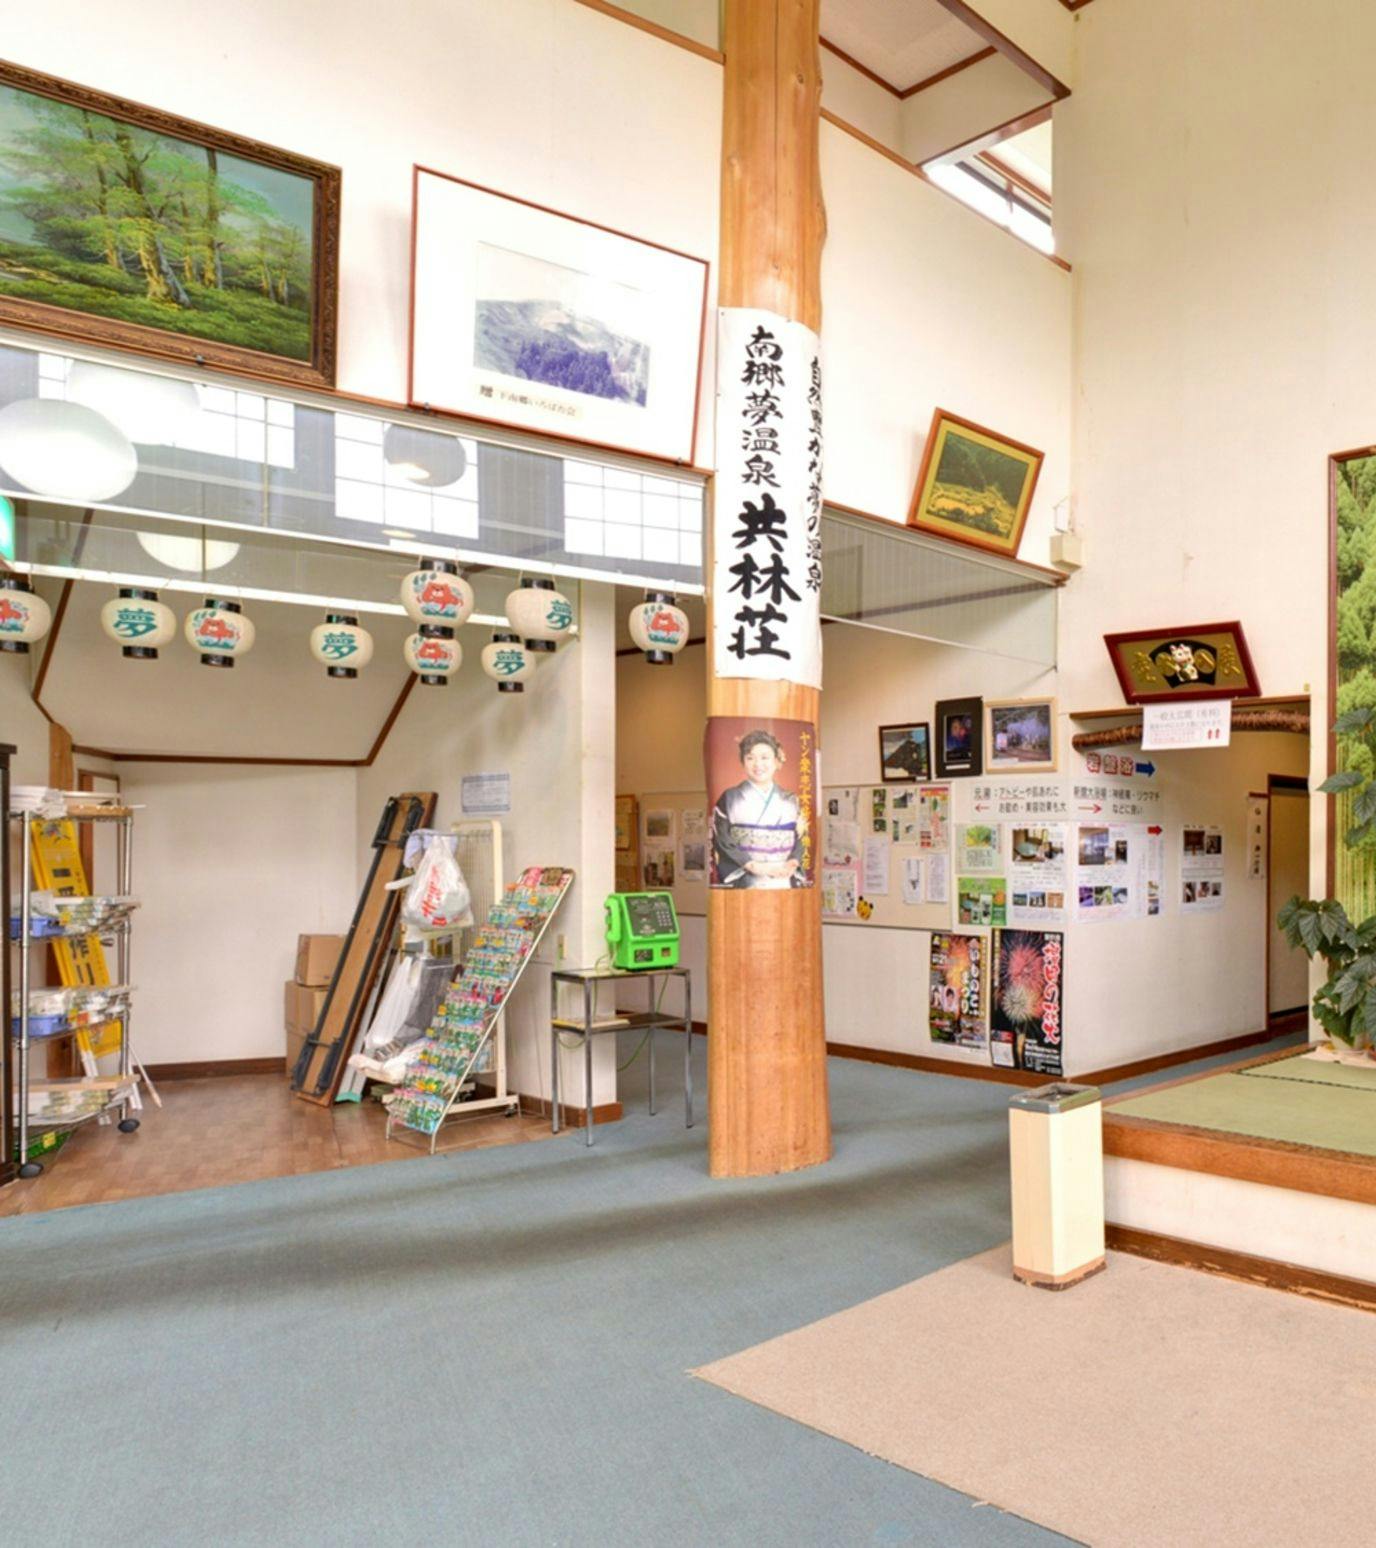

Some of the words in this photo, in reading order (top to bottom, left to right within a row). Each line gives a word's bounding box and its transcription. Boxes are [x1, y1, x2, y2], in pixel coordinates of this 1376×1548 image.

[740, 325, 785, 488] 南郷夢温泉
[727, 492, 802, 660] 共林荘
[113, 607, 158, 638] 夢
[545, 599, 572, 631] 夢
[321, 631, 358, 660] 夢
[493, 649, 526, 676] 夢
